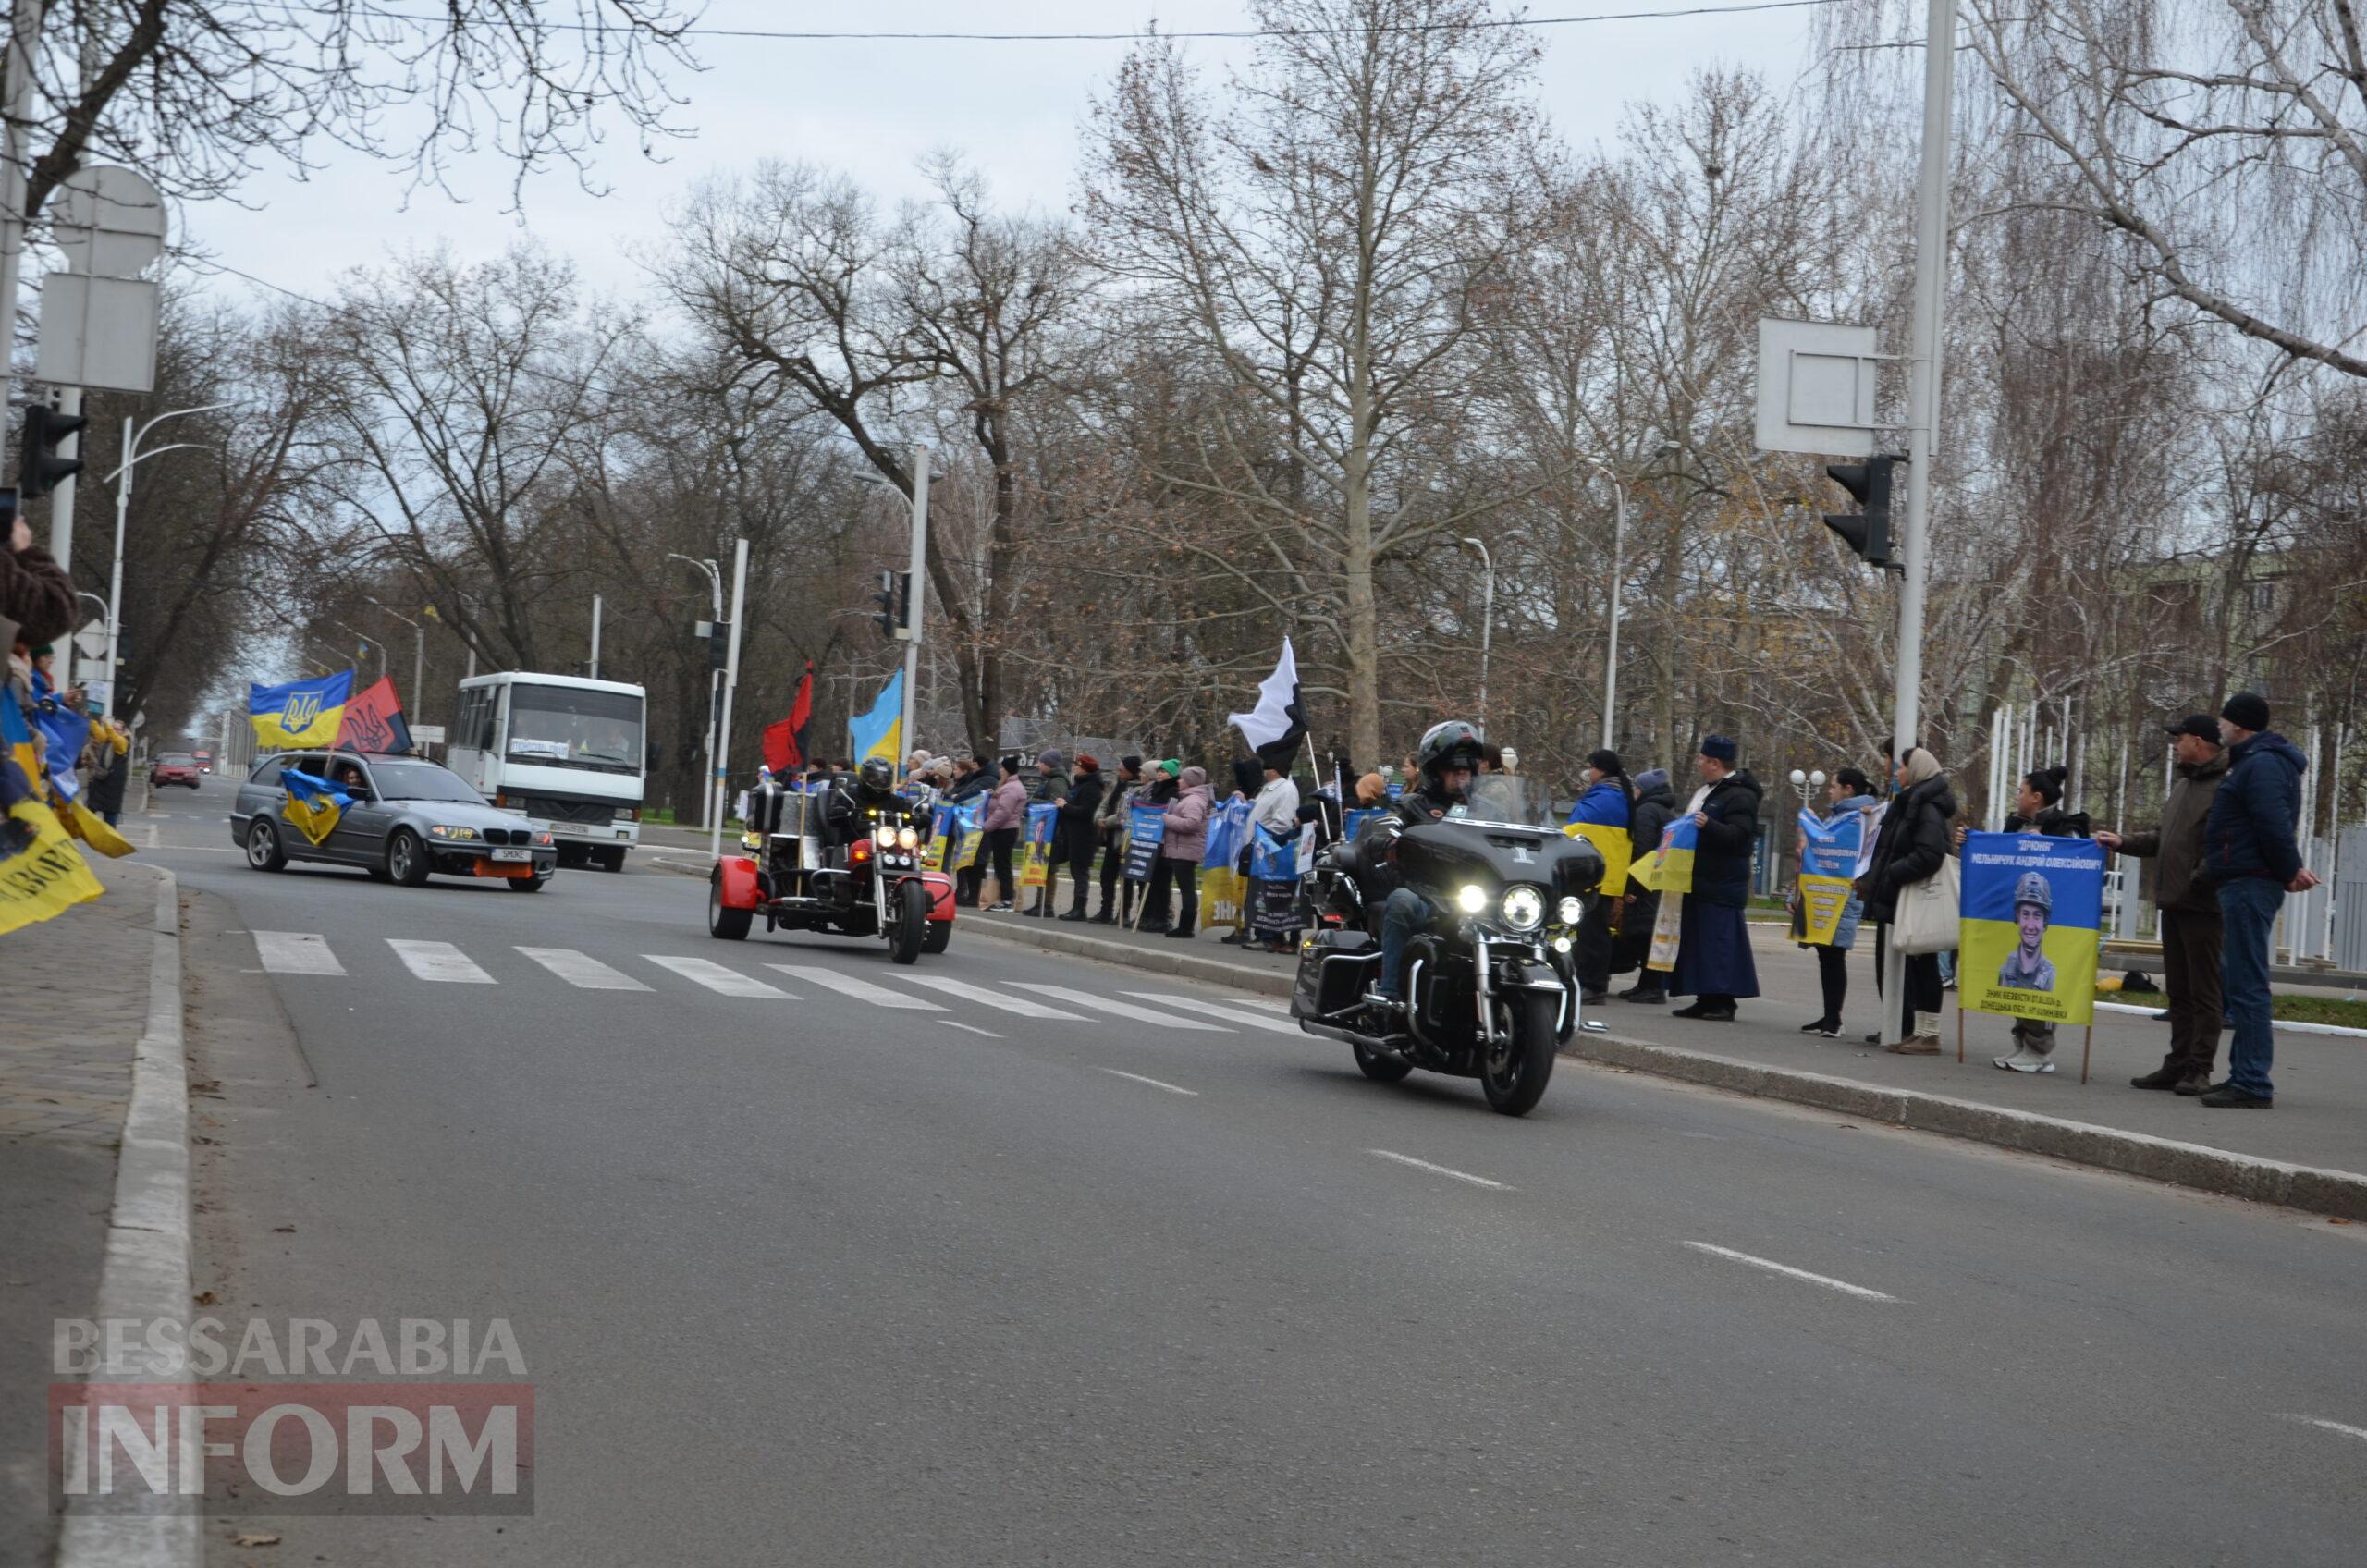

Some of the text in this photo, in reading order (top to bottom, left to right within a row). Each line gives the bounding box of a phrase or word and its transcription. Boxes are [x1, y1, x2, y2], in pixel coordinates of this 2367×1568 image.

[503, 850, 524, 859] SMOKE
[1971, 853, 2015, 866] МЕЛЬНИЧУК
[2015, 854, 2045, 868] АНДРІЙ
